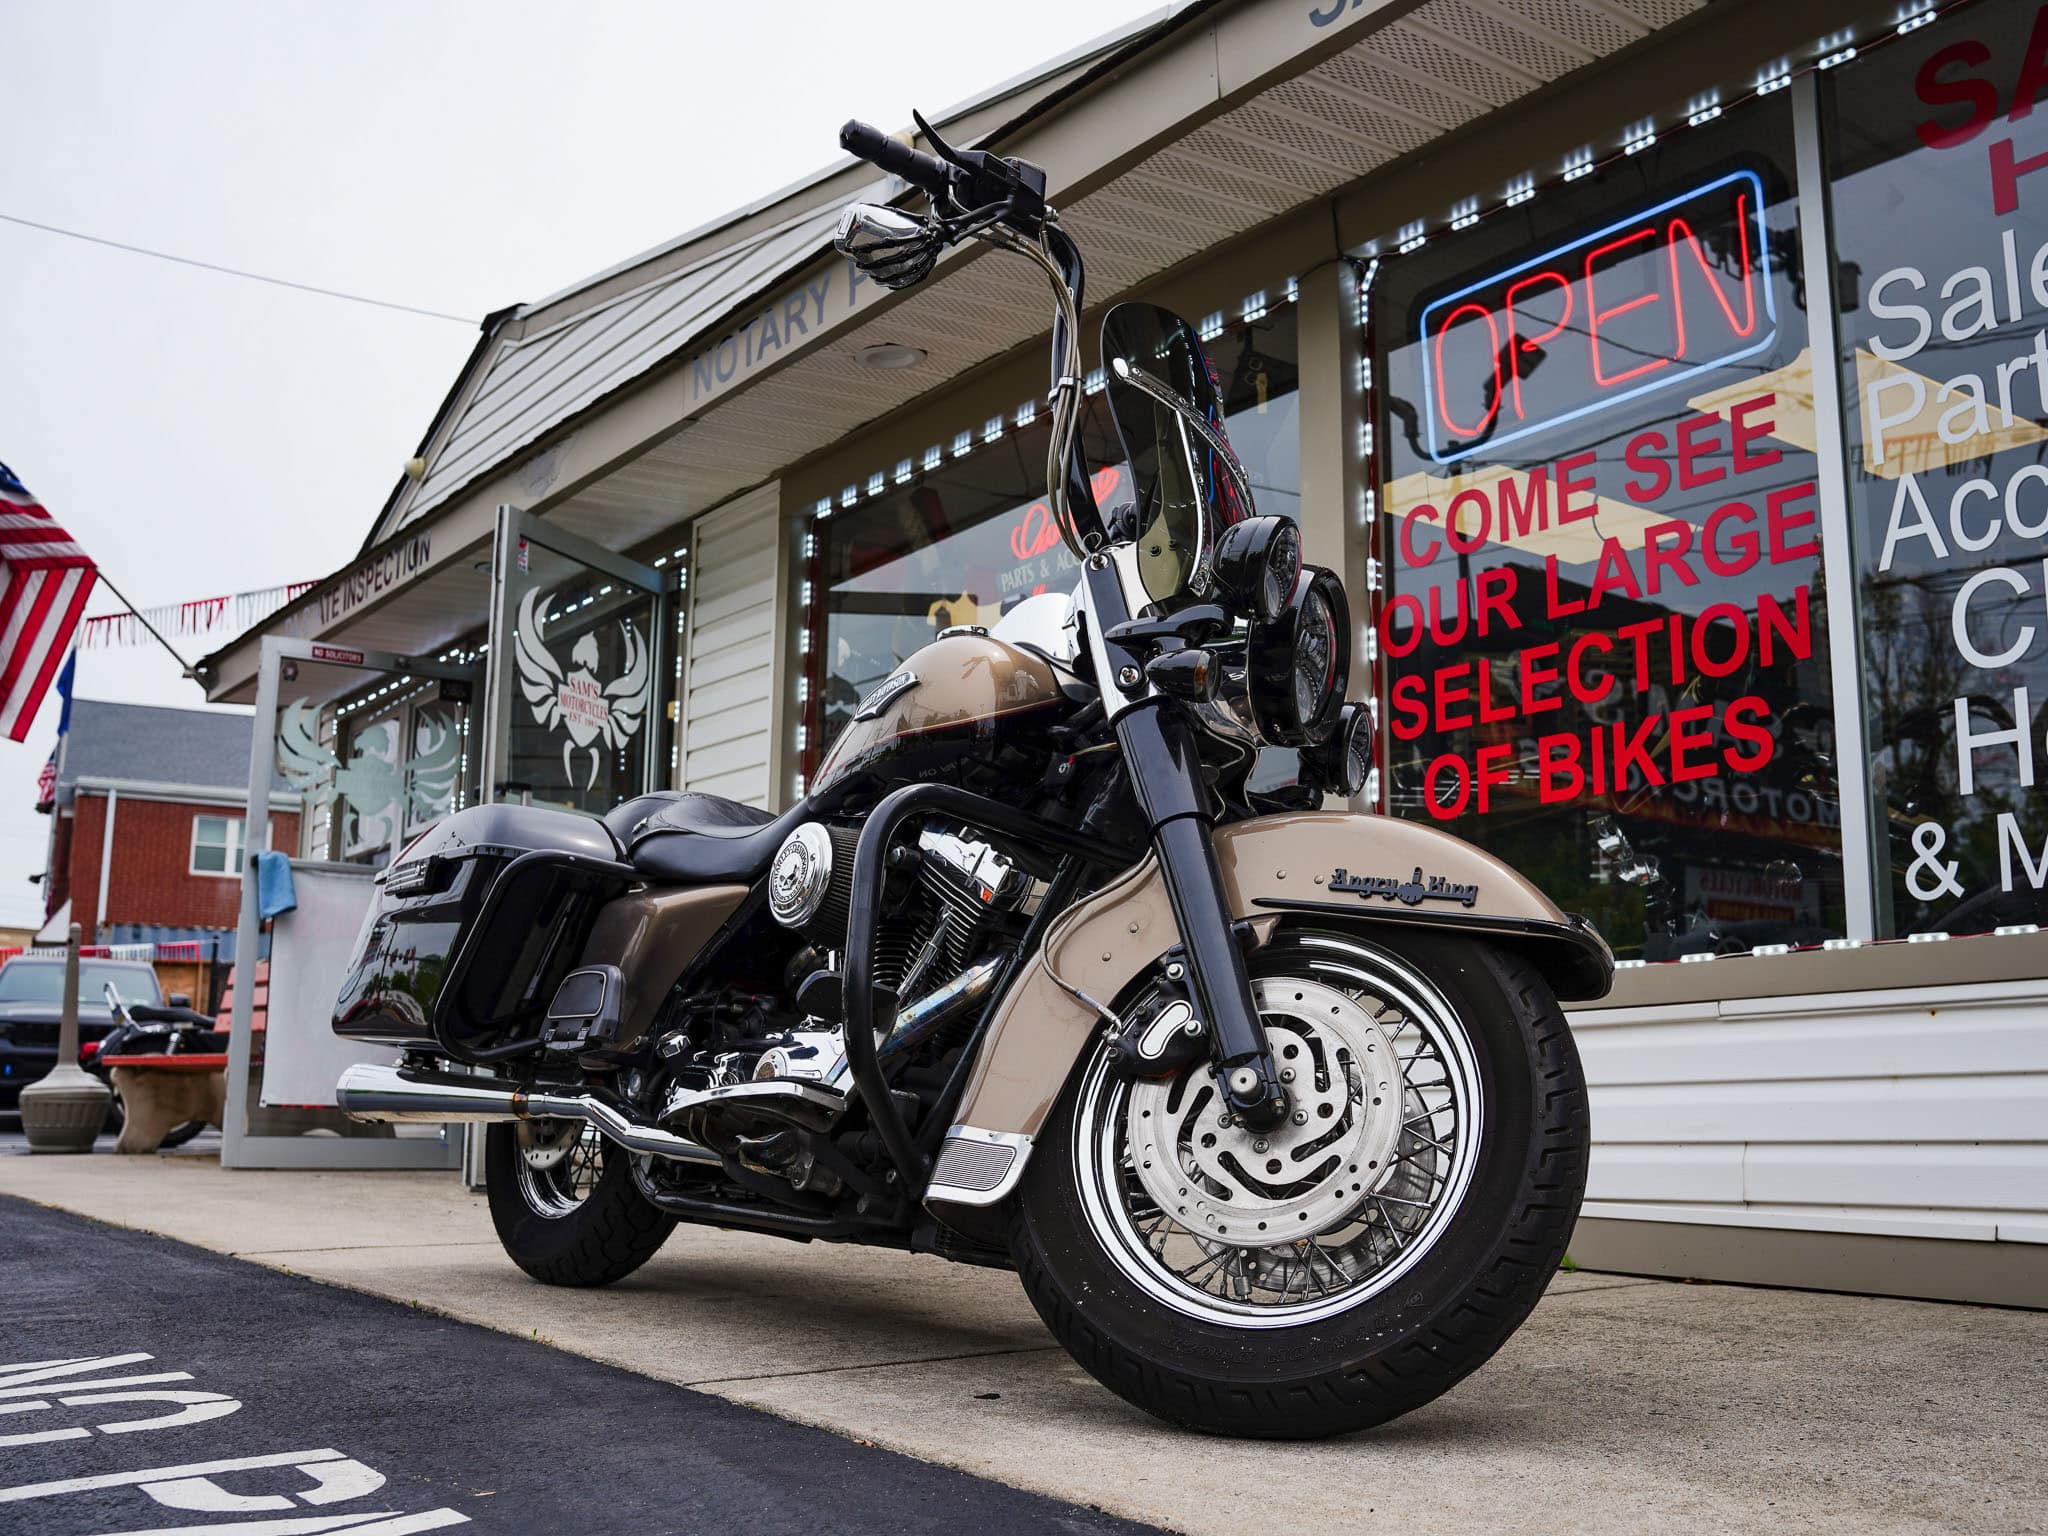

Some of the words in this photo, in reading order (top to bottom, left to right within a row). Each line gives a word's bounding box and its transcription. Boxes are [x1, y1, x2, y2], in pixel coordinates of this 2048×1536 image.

[693, 271, 832, 401] NOTARY
[1435, 192, 1756, 437] OPEN
[1400, 451, 1600, 568] COME
[1625, 392, 1782, 503] SEE
[342, 531, 433, 612] INSPECTION
[1001, 565, 1036, 593] PARTS
[1039, 558, 1050, 577] &
[1377, 566, 1524, 659] OUR
[1545, 482, 1820, 621] LARGE
[559, 692, 609, 721] MOTORCYCLES
[569, 677, 599, 701] SAM'S
[1390, 585, 1812, 741] SELECTION
[1423, 740, 1514, 821] OF
[1537, 694, 1776, 806] BIKES
[1954, 686, 2048, 796] H
[1905, 821, 1965, 901] &
